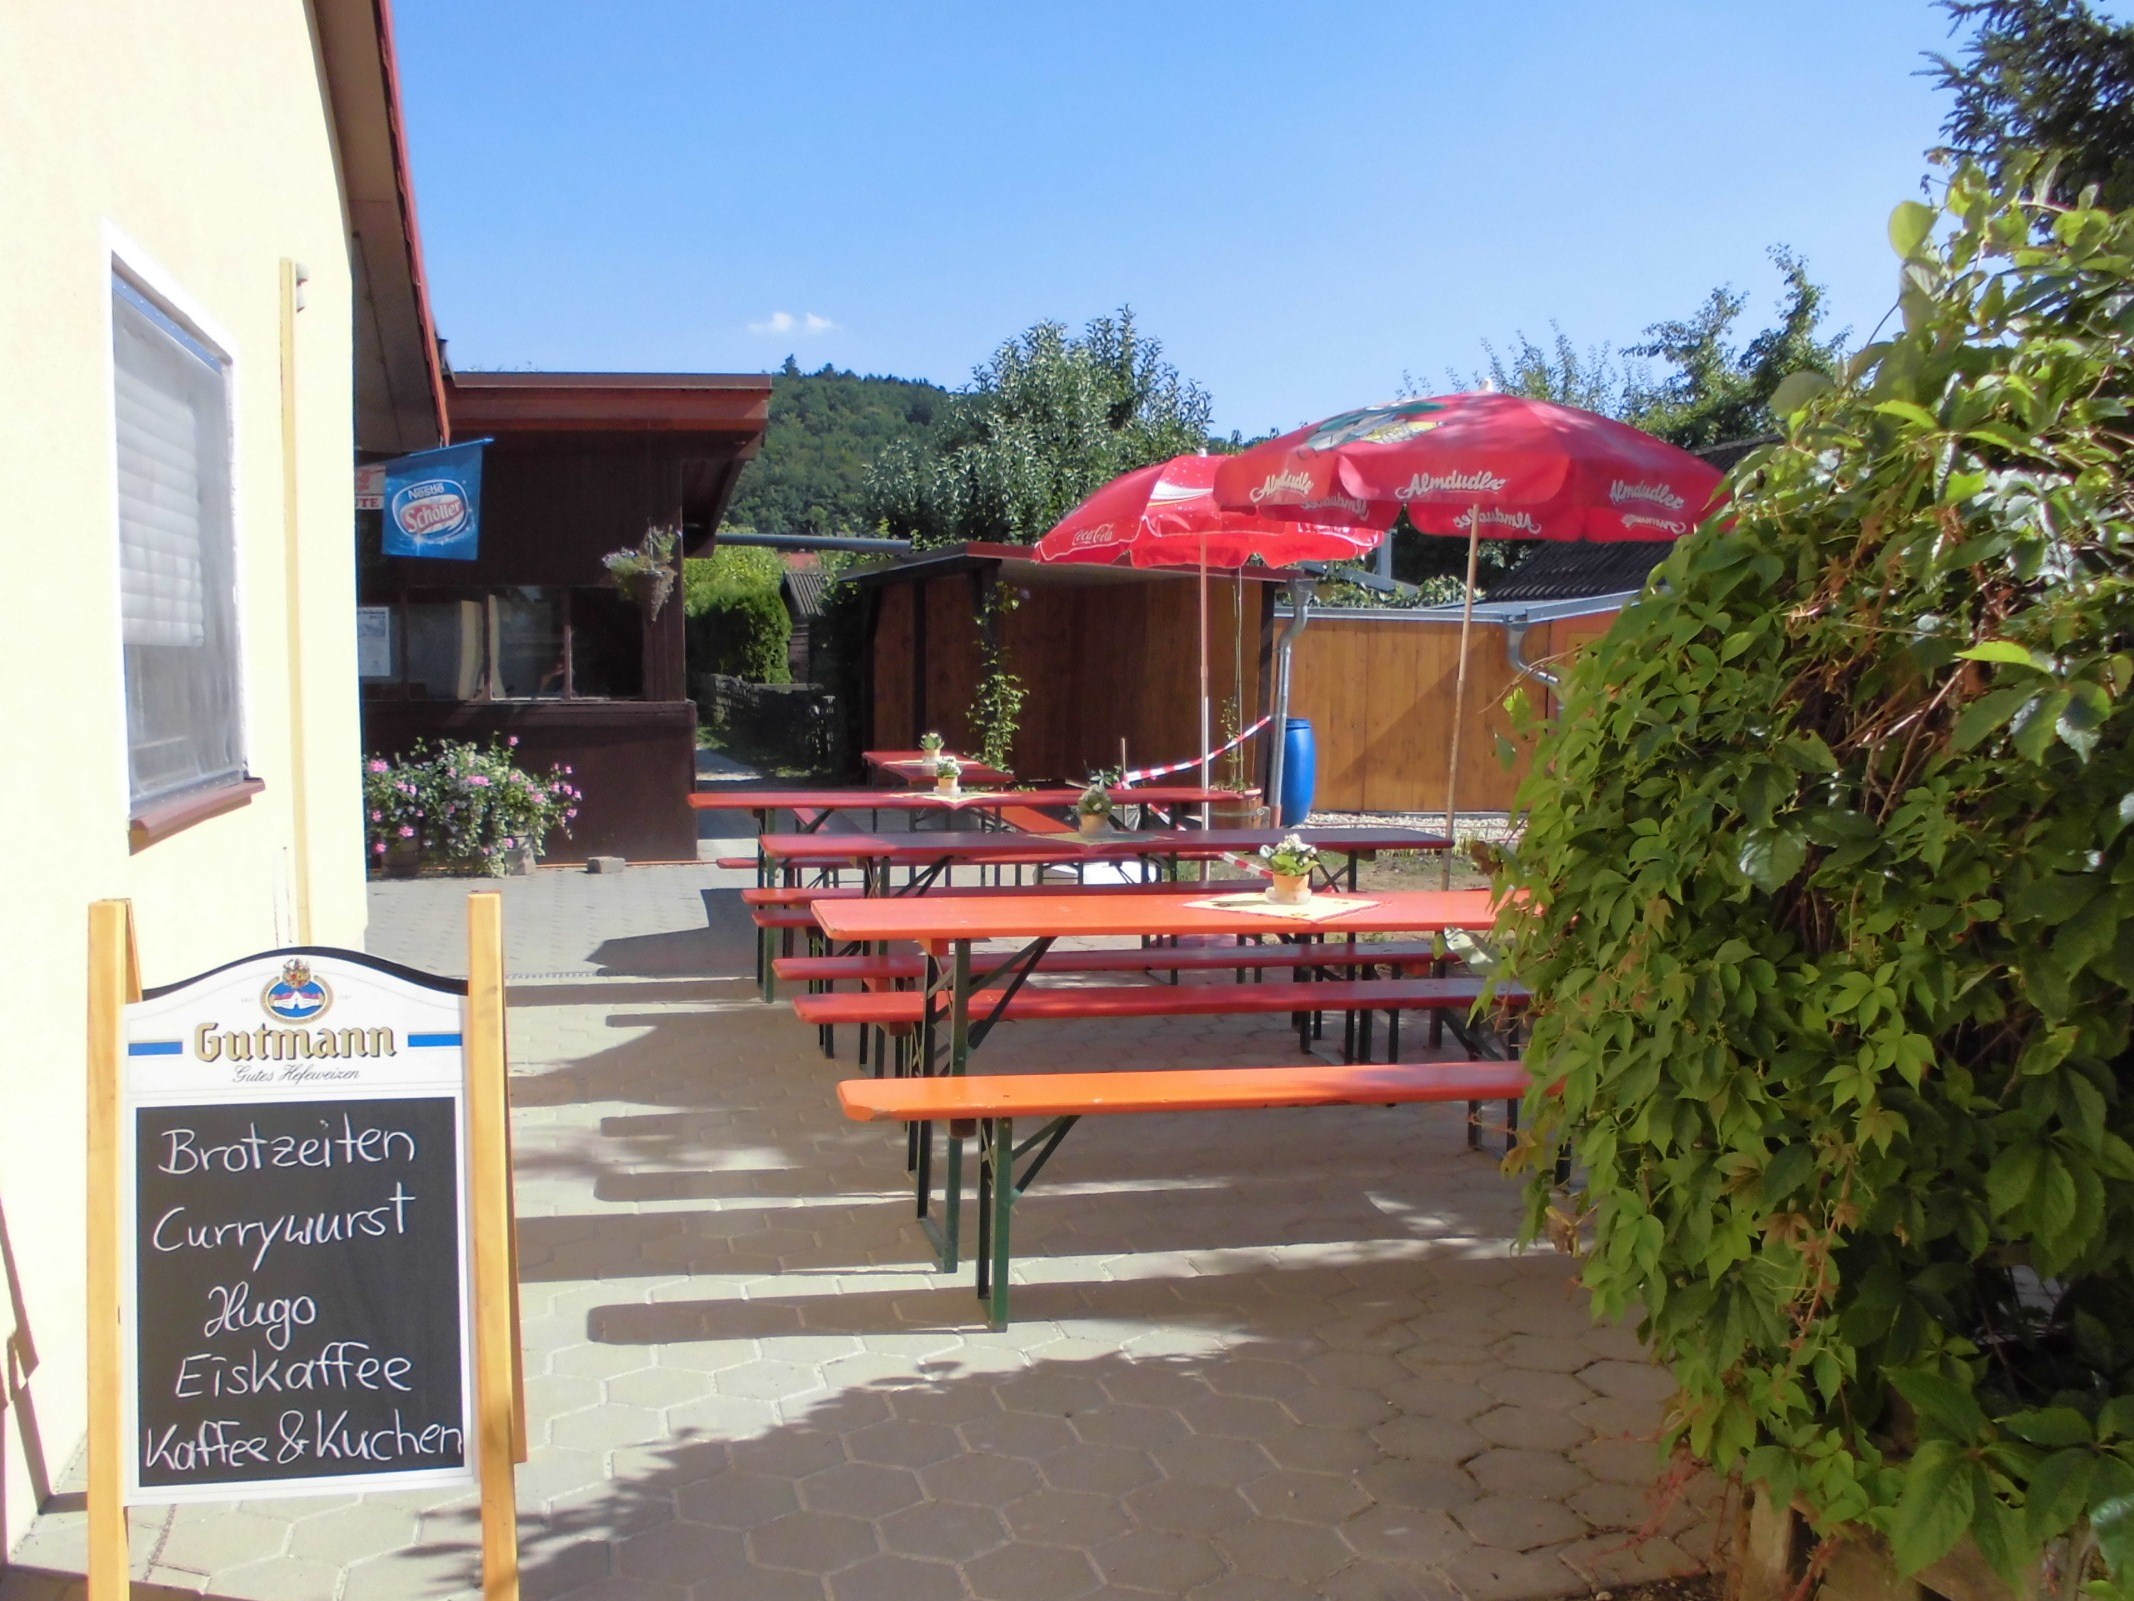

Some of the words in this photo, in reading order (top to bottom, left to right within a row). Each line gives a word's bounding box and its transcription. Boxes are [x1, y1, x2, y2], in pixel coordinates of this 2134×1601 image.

[404, 500, 464, 534] Schöller
[408, 483, 445, 500] Nestlé
[193, 1022, 397, 1063] Gutmann
[232, 1065, 275, 1083] Gutes
[278, 1063, 360, 1085] Hefeweizen
[158, 1112, 415, 1174] Brotzeiten
[153, 1182, 416, 1271] Currywurst
[204, 1280, 317, 1351] Hugo
[175, 1342, 415, 1397] Eiskaffee
[146, 1420, 269, 1471] Kaffee
[276, 1409, 310, 1464] &
[316, 1408, 464, 1462] Kuchen
